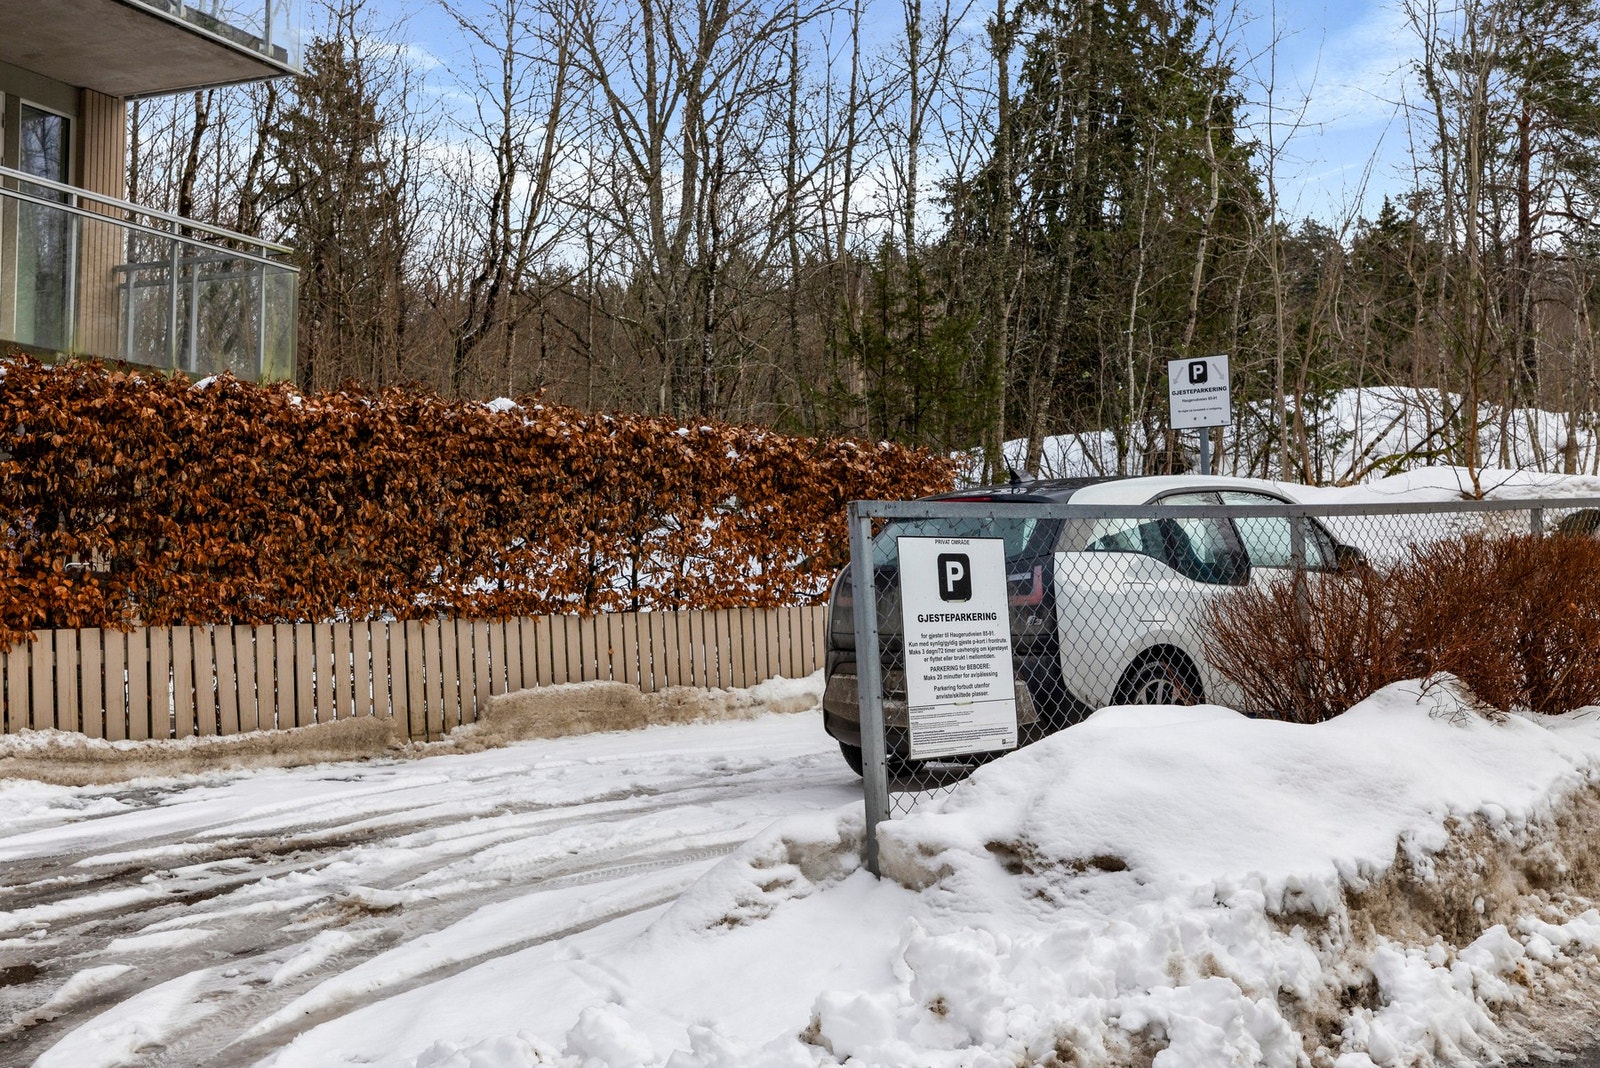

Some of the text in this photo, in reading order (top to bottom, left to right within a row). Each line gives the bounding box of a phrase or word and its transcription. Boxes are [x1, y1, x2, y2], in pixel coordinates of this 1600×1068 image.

[1192, 364, 1204, 380] P
[1172, 386, 1227, 396] GJESTEPARKERING
[946, 561, 964, 592] P
[918, 612, 997, 623] GJESTEPARKERING
